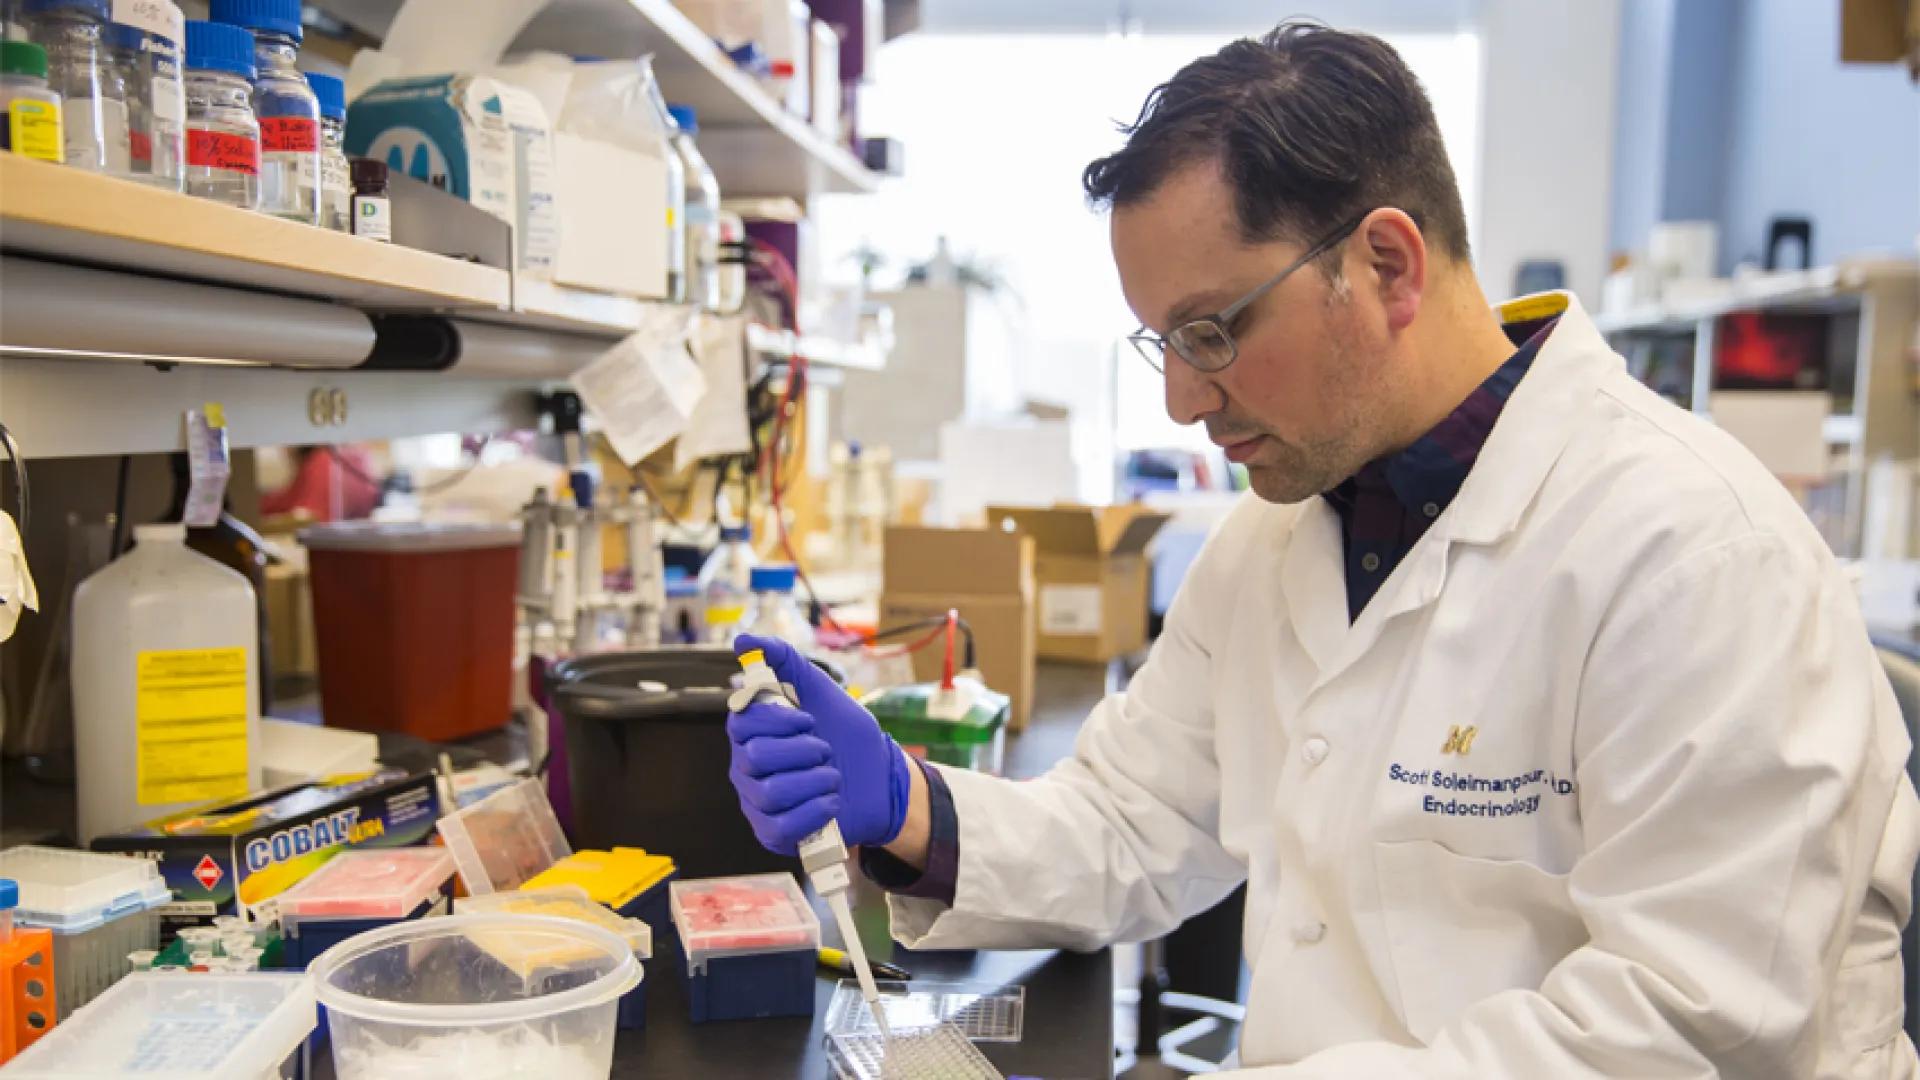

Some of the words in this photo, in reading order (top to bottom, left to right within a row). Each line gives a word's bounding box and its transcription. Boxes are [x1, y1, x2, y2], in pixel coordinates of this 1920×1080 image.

[361, 202, 377, 217] D
[1389, 763, 1430, 785] Scott
[1423, 794, 1540, 818] Endocrinology
[246, 806, 361, 873] COBALT
